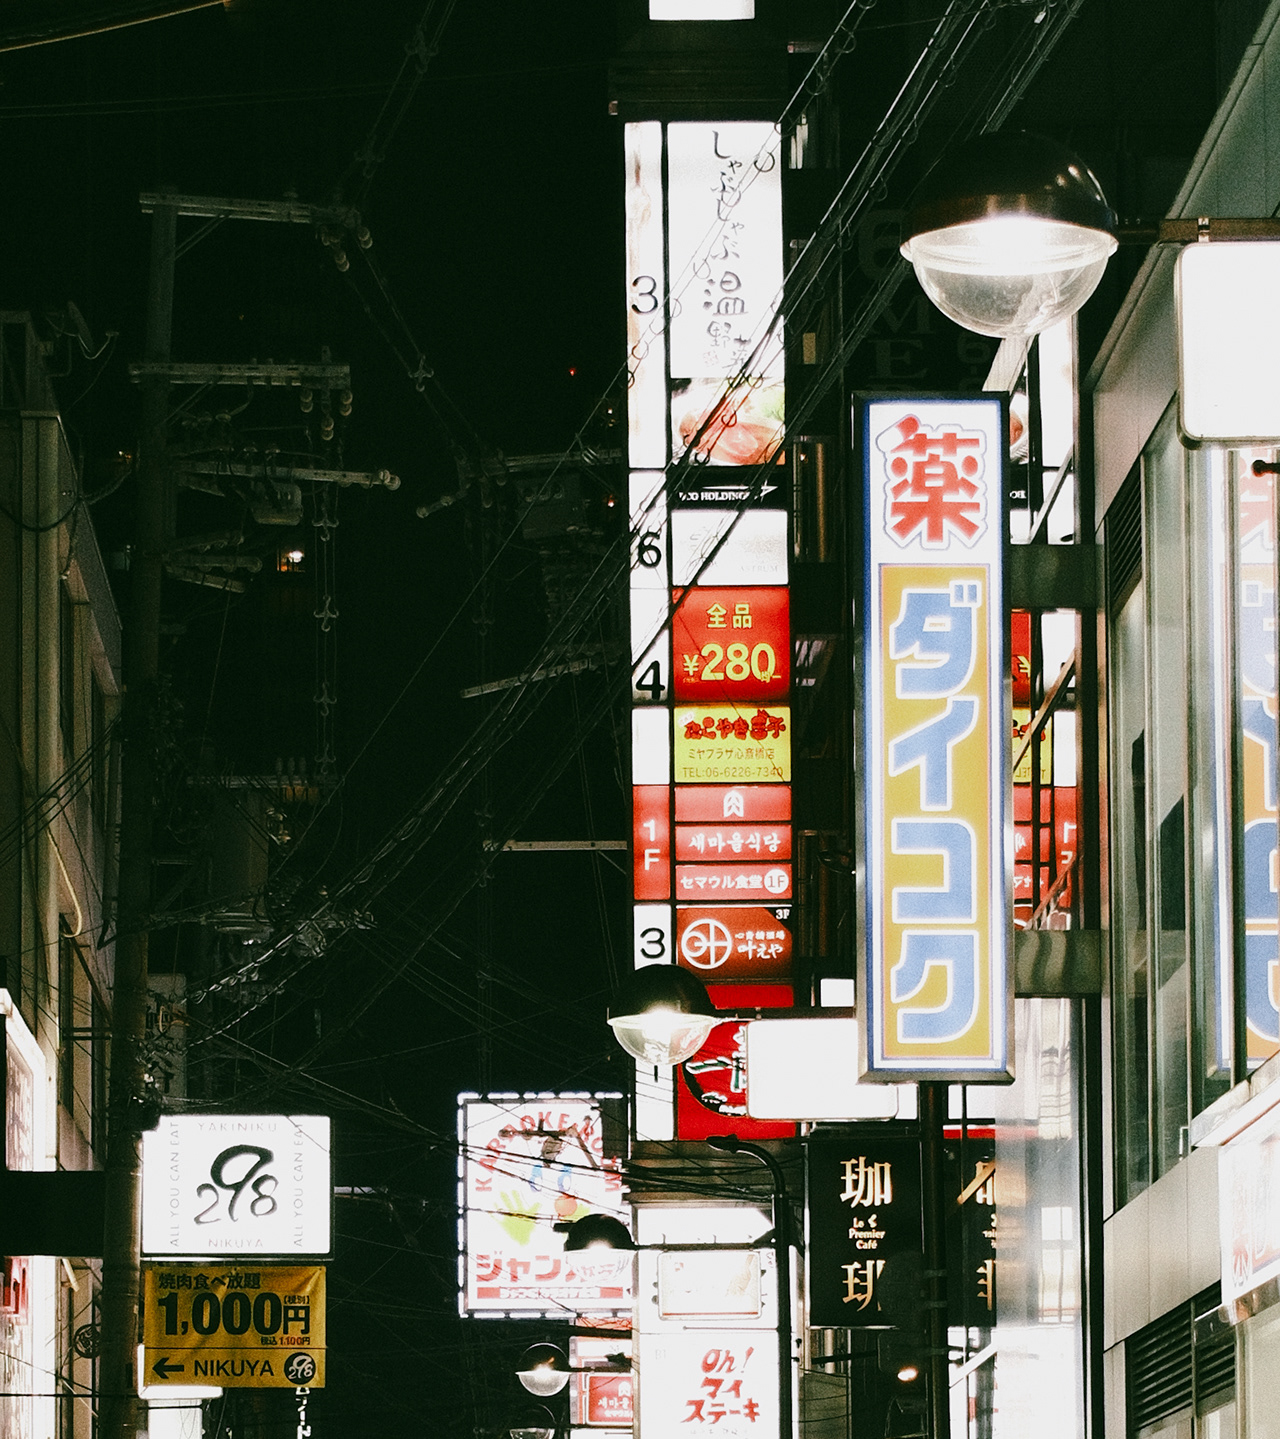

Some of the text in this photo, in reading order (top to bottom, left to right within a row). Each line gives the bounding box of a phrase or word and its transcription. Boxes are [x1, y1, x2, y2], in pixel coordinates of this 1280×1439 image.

[631, 276, 659, 314] 3
[877, 415, 984, 543] 薬
[706, 603, 753, 629] 全品
[636, 660, 666, 699] 4
[888, 582, 979, 1045] ダイコク
[688, 832, 782, 854] 새마을식당
[680, 875, 764, 890] セマウル食堂
[640, 927, 666, 959] 3
[197, 1121, 278, 1133] YAKINIKU
[158, 1271, 261, 1290] 焼肉食べ放題
[193, 1358, 275, 1377] NIKUYA
[701, 1346, 755, 1374] Oh!
[700, 1376, 744, 1399] マイ
[680, 1397, 761, 1425] ステーキ
